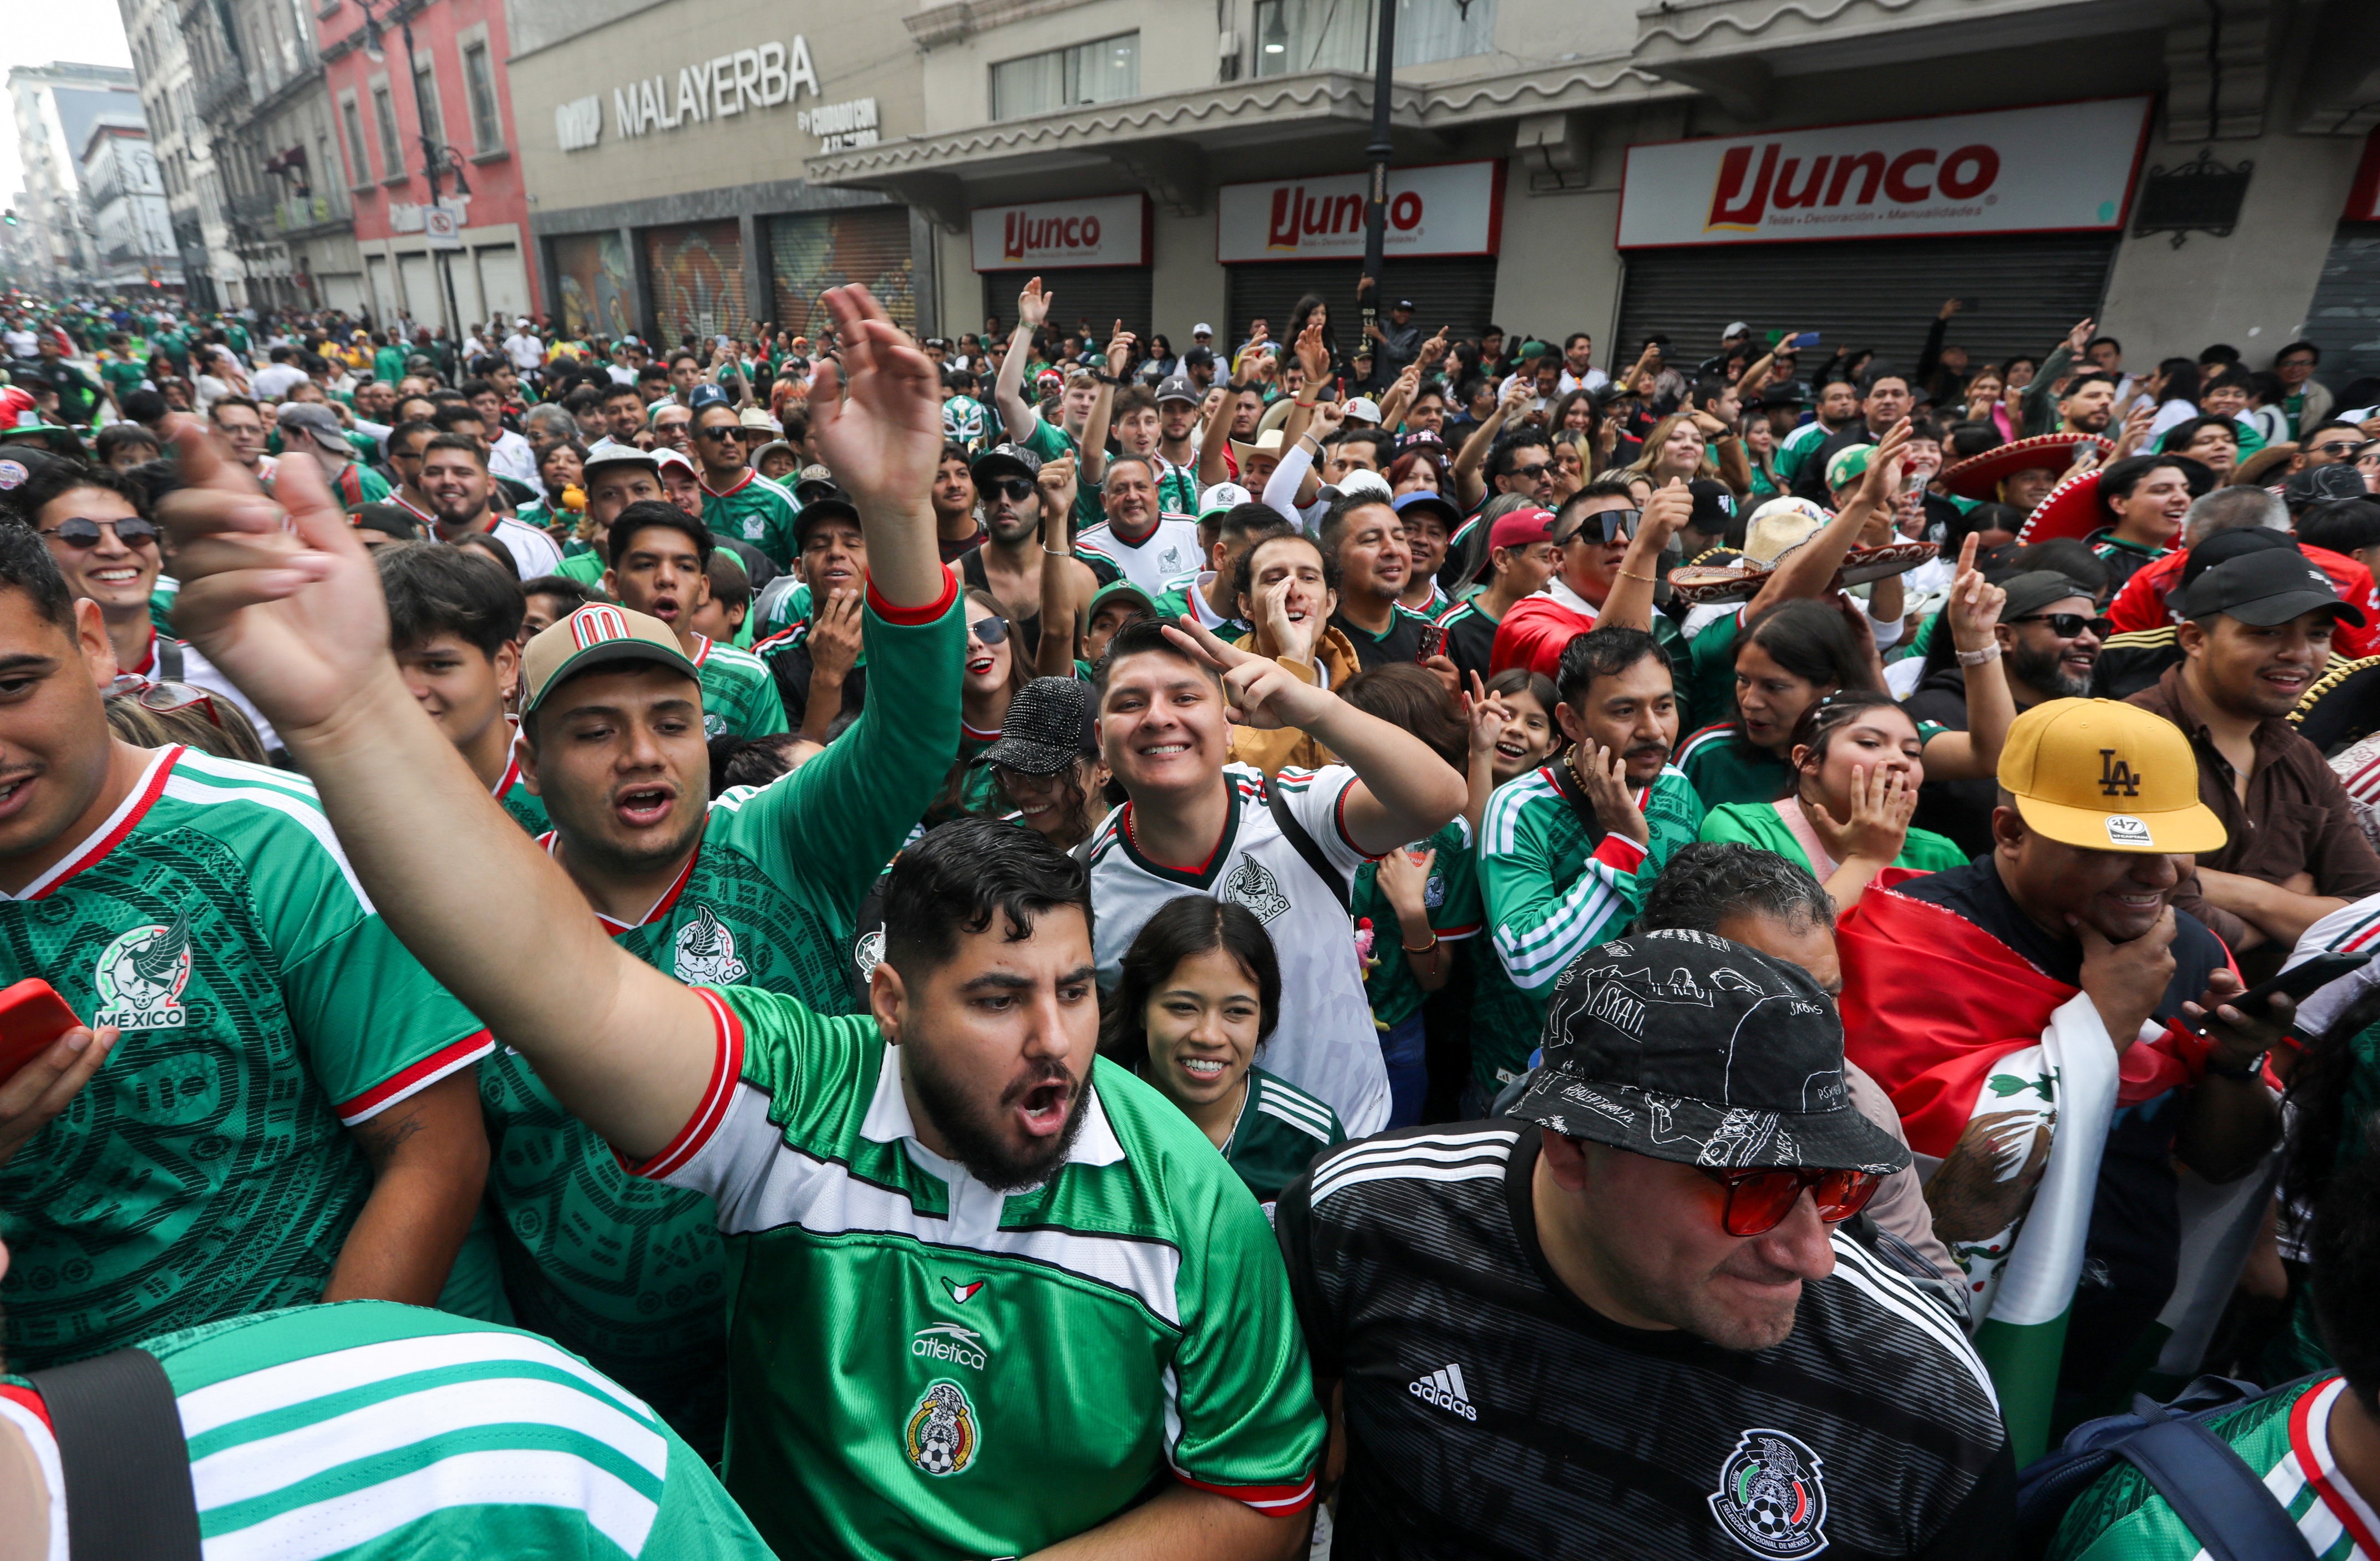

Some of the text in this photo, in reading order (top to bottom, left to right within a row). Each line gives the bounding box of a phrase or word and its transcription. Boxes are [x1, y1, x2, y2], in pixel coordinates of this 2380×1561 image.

[613, 33, 821, 139] MALAYERBA
[1709, 144, 2001, 226] Junco
[1004, 210, 1100, 258] Junco
[1804, 212, 1875, 223] Decoración
[1889, 206, 1982, 220] Manualidades
[2099, 749, 2140, 796] LA
[97, 1009, 182, 1028] MÉXICO
[911, 1337, 985, 1371] atletica
[1409, 1381, 1477, 1421] adidas
[1731, 1470, 1741, 1492] PASIÓN
[1722, 1503, 1748, 1534] SELECCIÓN
[1747, 1531, 1777, 1549] NACIONAL
[1788, 1535, 1810, 1549] MÉXICO
[1802, 1497, 1813, 1524] ORGULLO
